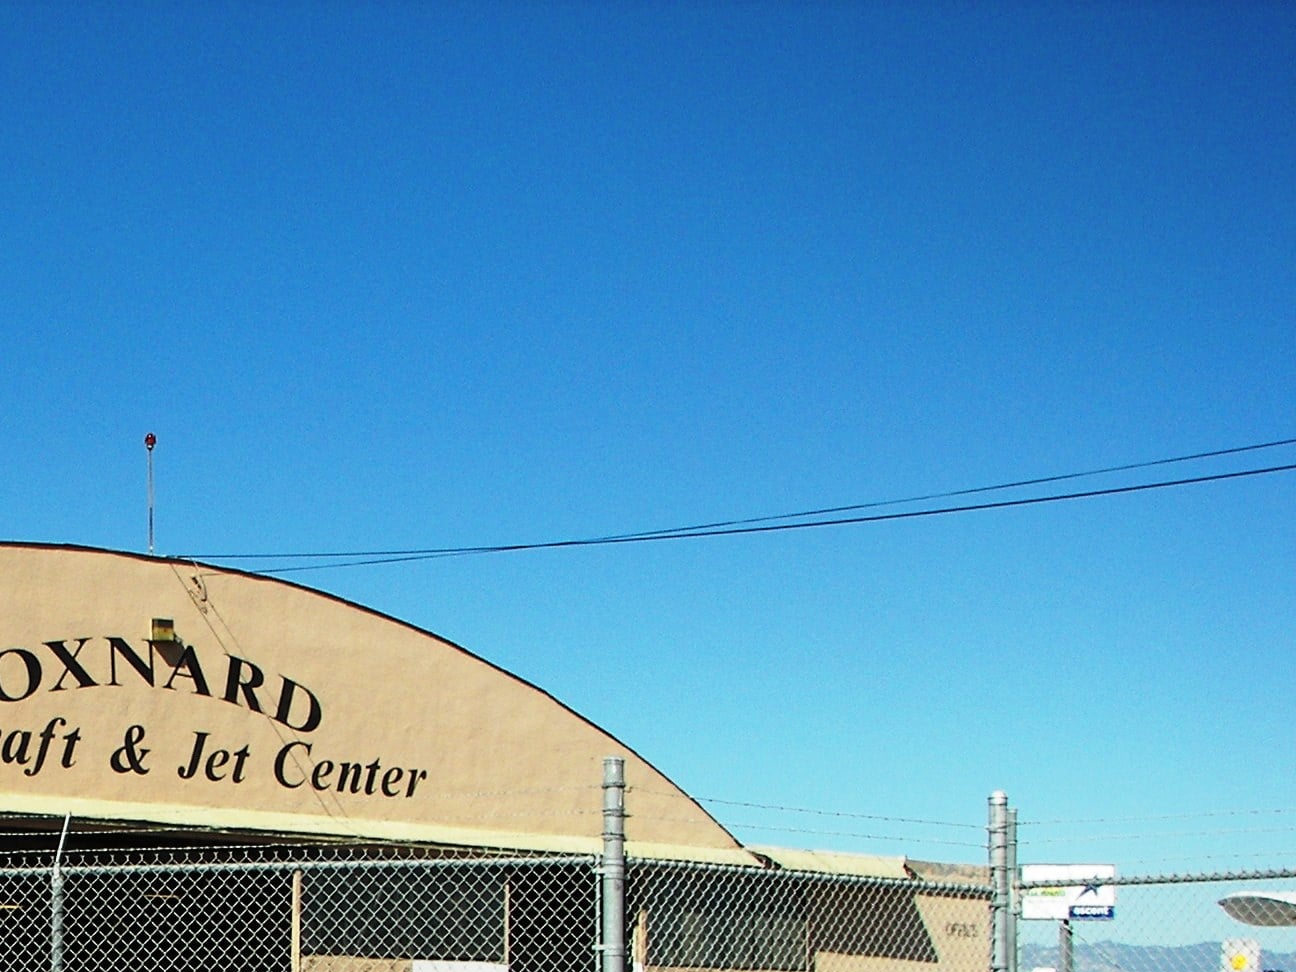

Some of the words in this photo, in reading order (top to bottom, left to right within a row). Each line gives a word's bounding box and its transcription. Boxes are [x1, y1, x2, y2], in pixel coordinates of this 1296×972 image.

[109, 724, 151, 776] &
[177, 731, 251, 784] Jet
[273, 740, 428, 798] Center
